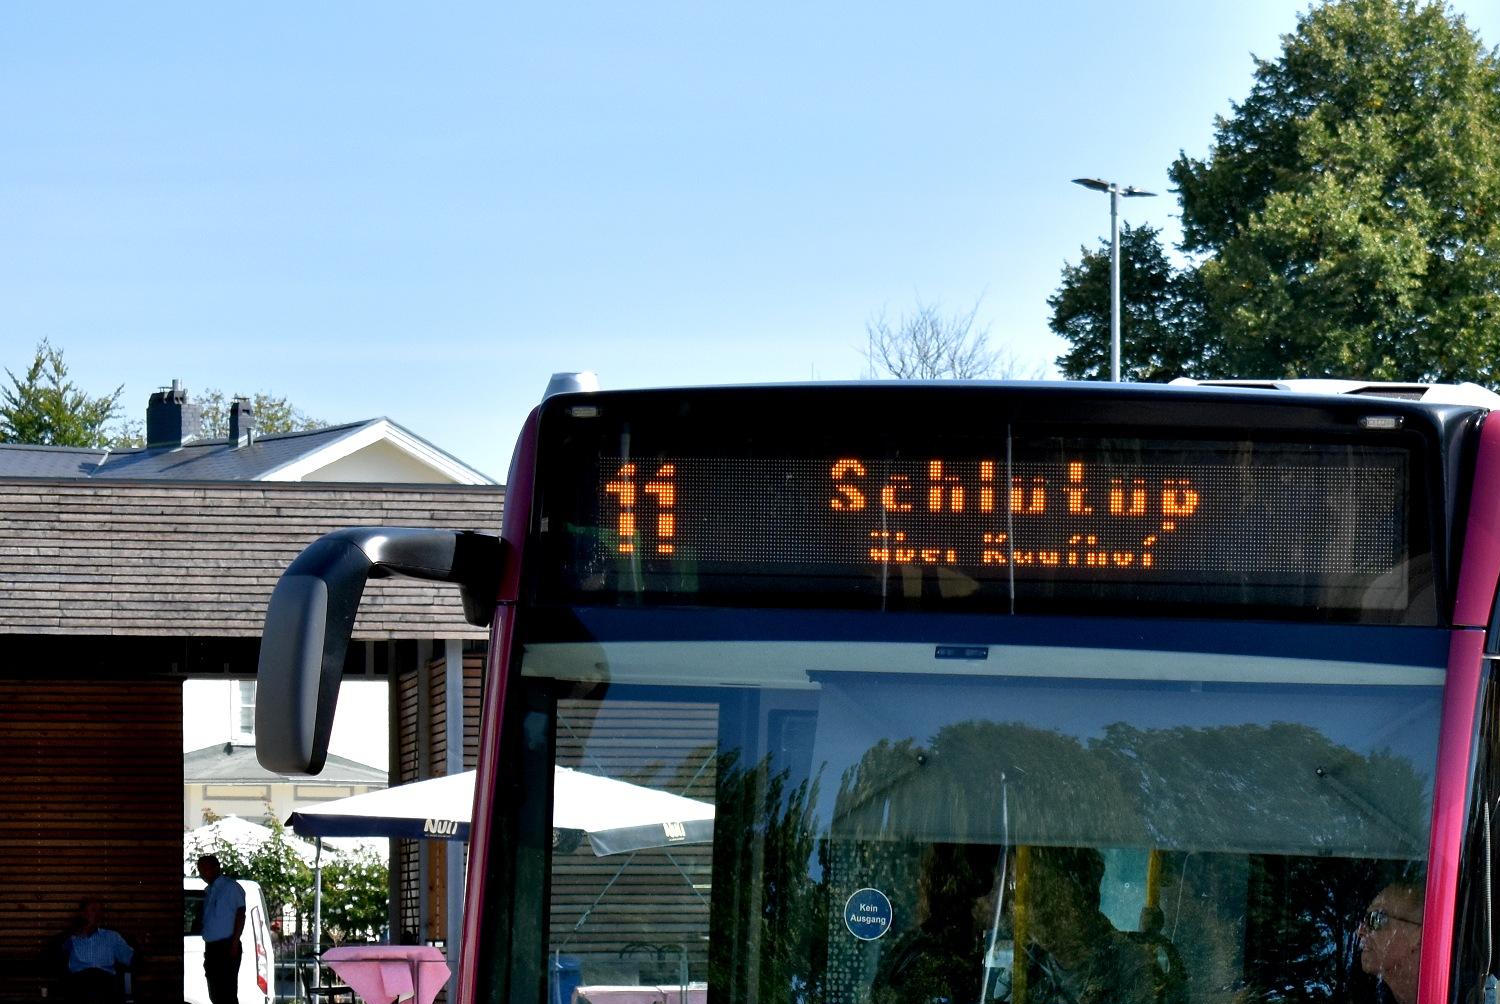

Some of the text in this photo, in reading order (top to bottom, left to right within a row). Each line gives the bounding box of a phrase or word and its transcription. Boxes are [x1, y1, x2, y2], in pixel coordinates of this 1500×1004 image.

[606, 463, 674, 553] 11
[831, 459, 1199, 531] Schlutup
[850, 914, 886, 926] Ausgang
[859, 903, 878, 913] Kein
